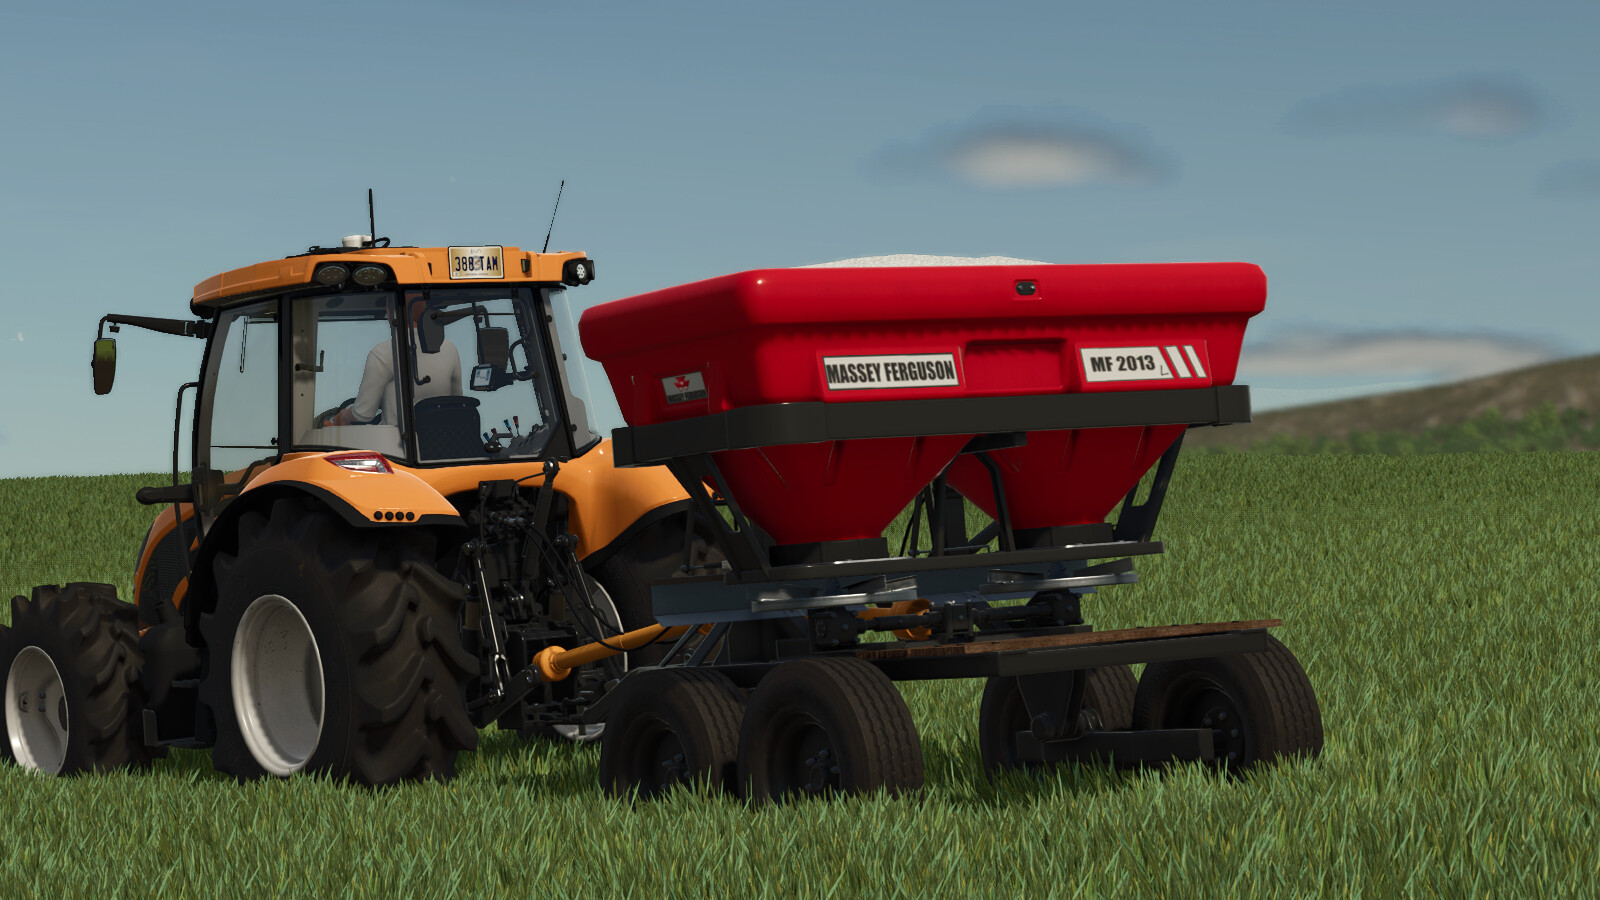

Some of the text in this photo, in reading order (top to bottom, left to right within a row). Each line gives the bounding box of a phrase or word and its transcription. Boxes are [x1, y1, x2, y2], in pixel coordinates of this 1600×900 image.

[455, 255, 498, 272] 388 TAM
[825, 360, 955, 384] MASSEY FERGUSON
[1090, 355, 1155, 372] MF 2013
